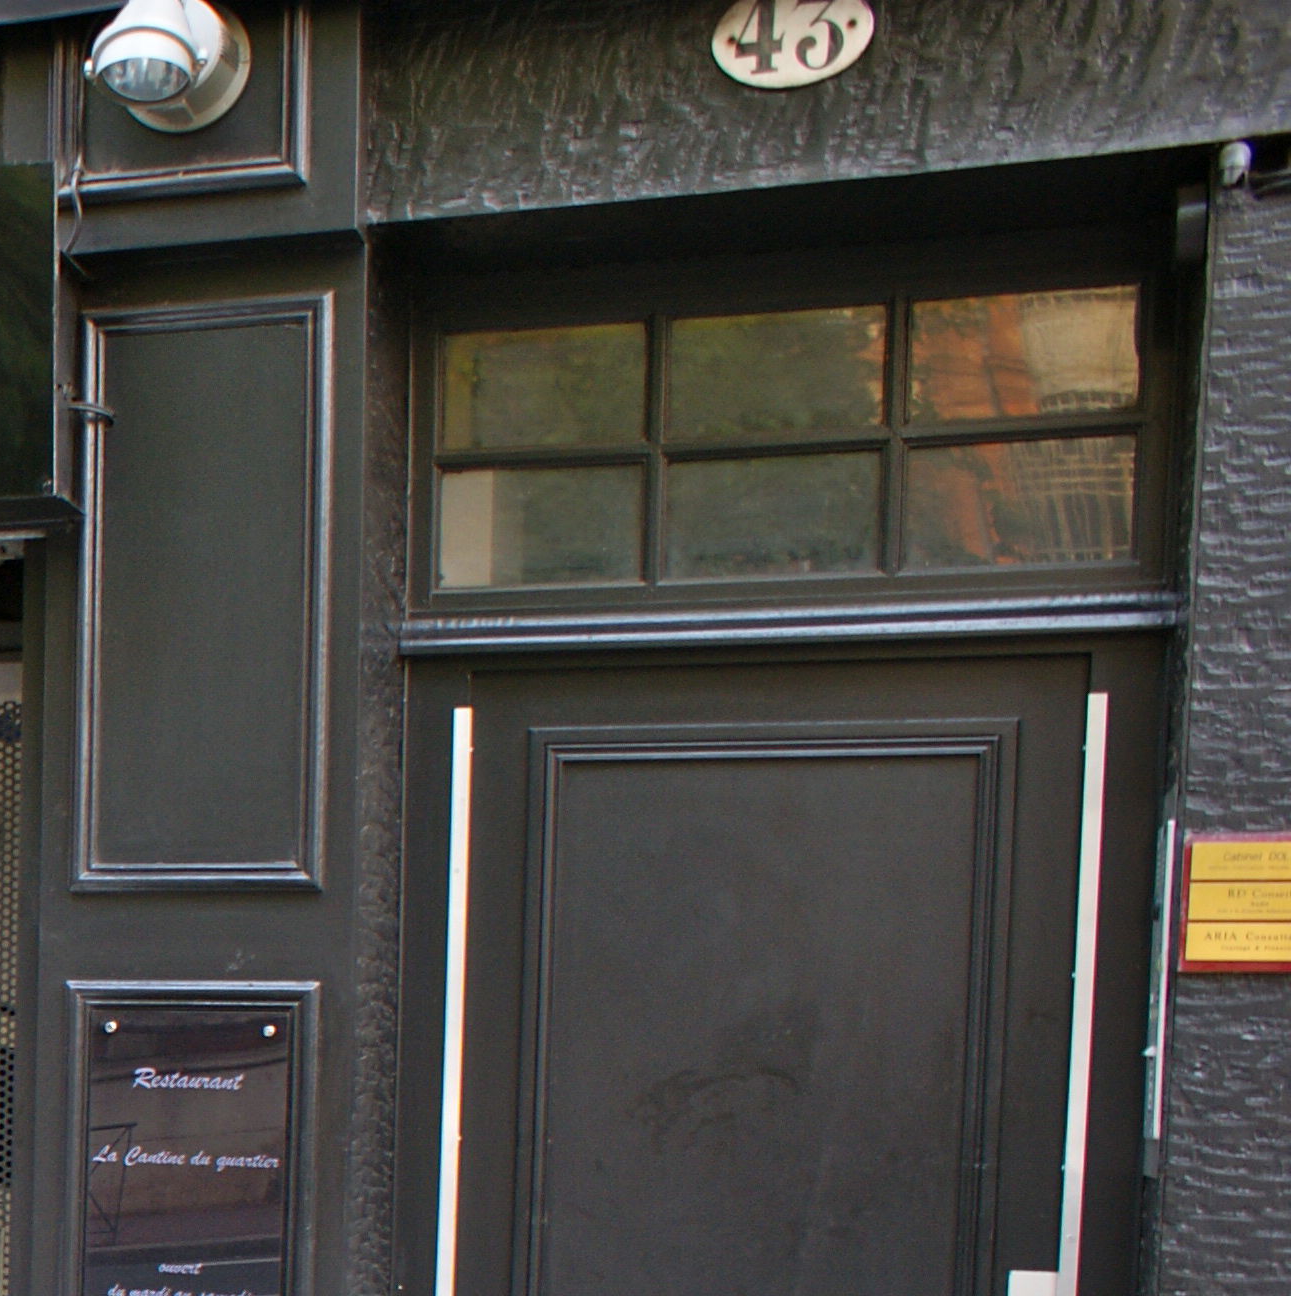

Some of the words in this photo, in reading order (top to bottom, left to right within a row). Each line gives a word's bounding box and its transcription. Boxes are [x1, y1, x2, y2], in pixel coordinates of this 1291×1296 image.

[734, 0, 845, 75] 43
[132, 1066, 245, 1091] Restaurant
[92, 1145, 117, 1163] La
[123, 1146, 185, 1167] Cantine
[190, 1151, 212, 1166] du
[216, 1154, 280, 1172] quartier
